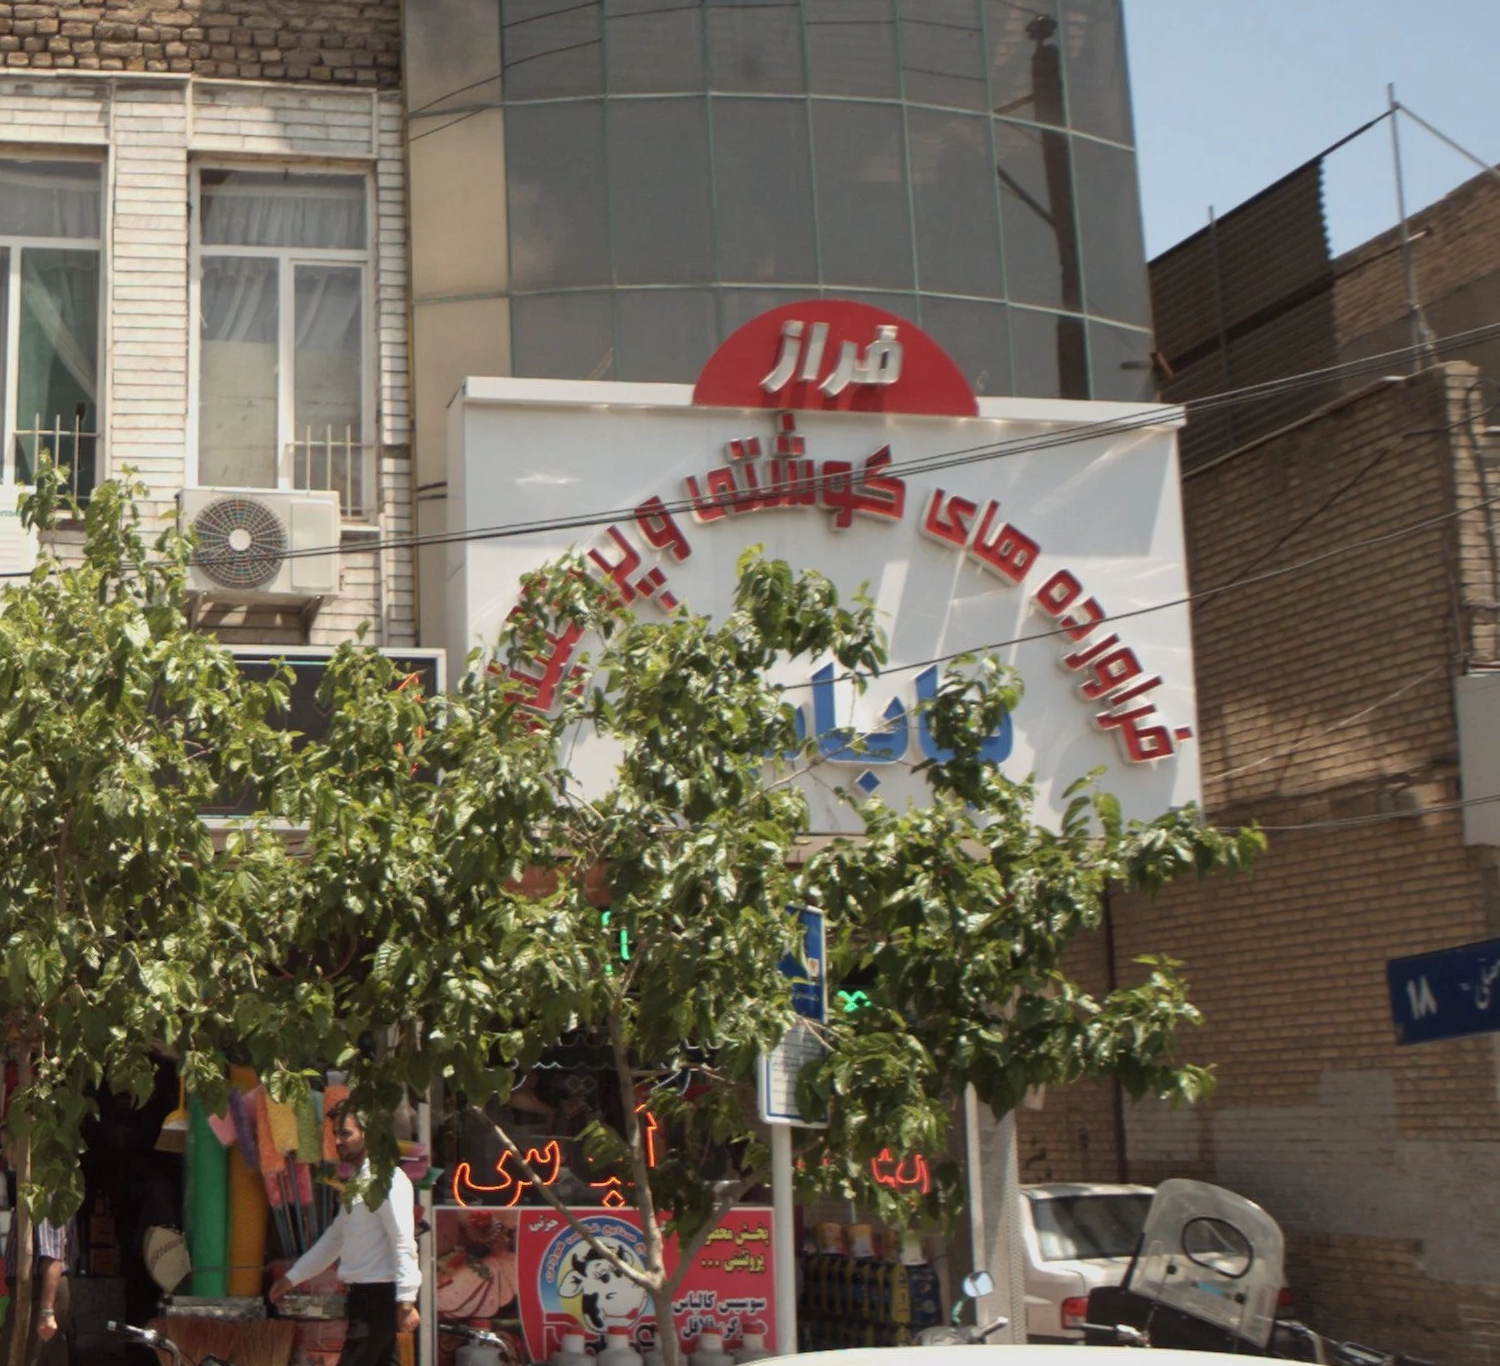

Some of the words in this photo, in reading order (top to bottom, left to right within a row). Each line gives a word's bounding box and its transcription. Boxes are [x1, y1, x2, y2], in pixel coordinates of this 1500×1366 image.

[760, 319, 904, 398] فراز
[633, 495, 692, 563] و
[924, 487, 1042, 585] های
